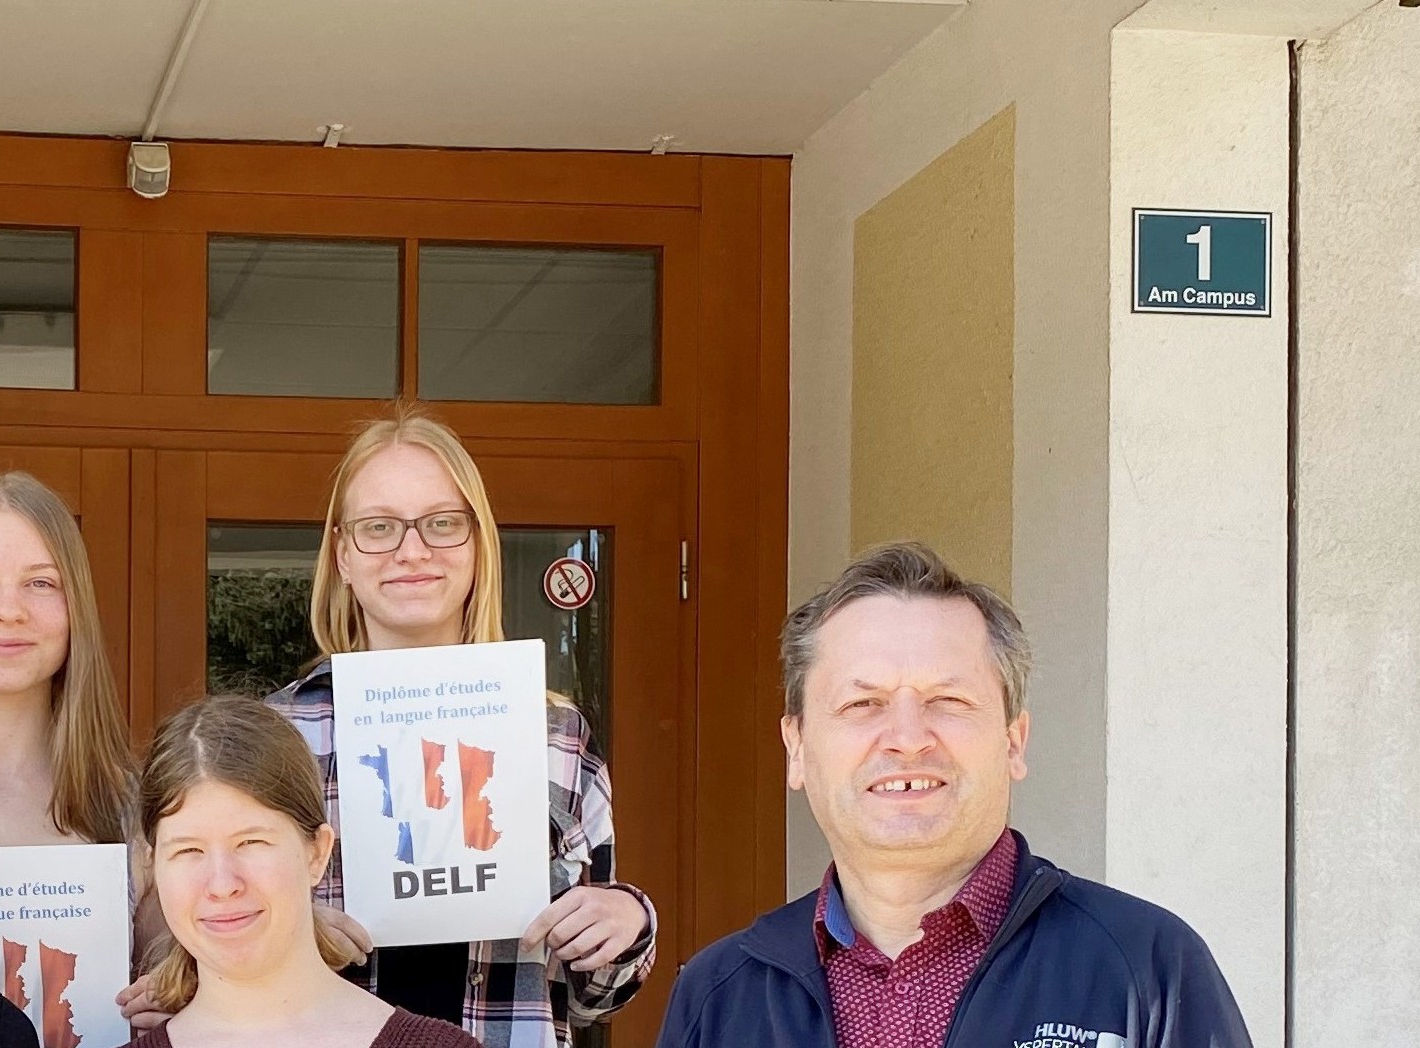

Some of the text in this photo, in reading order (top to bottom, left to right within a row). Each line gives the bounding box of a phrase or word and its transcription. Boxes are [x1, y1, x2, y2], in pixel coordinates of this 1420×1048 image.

[1186, 224, 1212, 281] 1
[1147, 286, 1256, 308] Am Campus
[365, 684, 431, 704] Diplôme
[354, 702, 509, 726] en langue française
[392, 862, 498, 900] DELF
[19, 905, 92, 921] française
